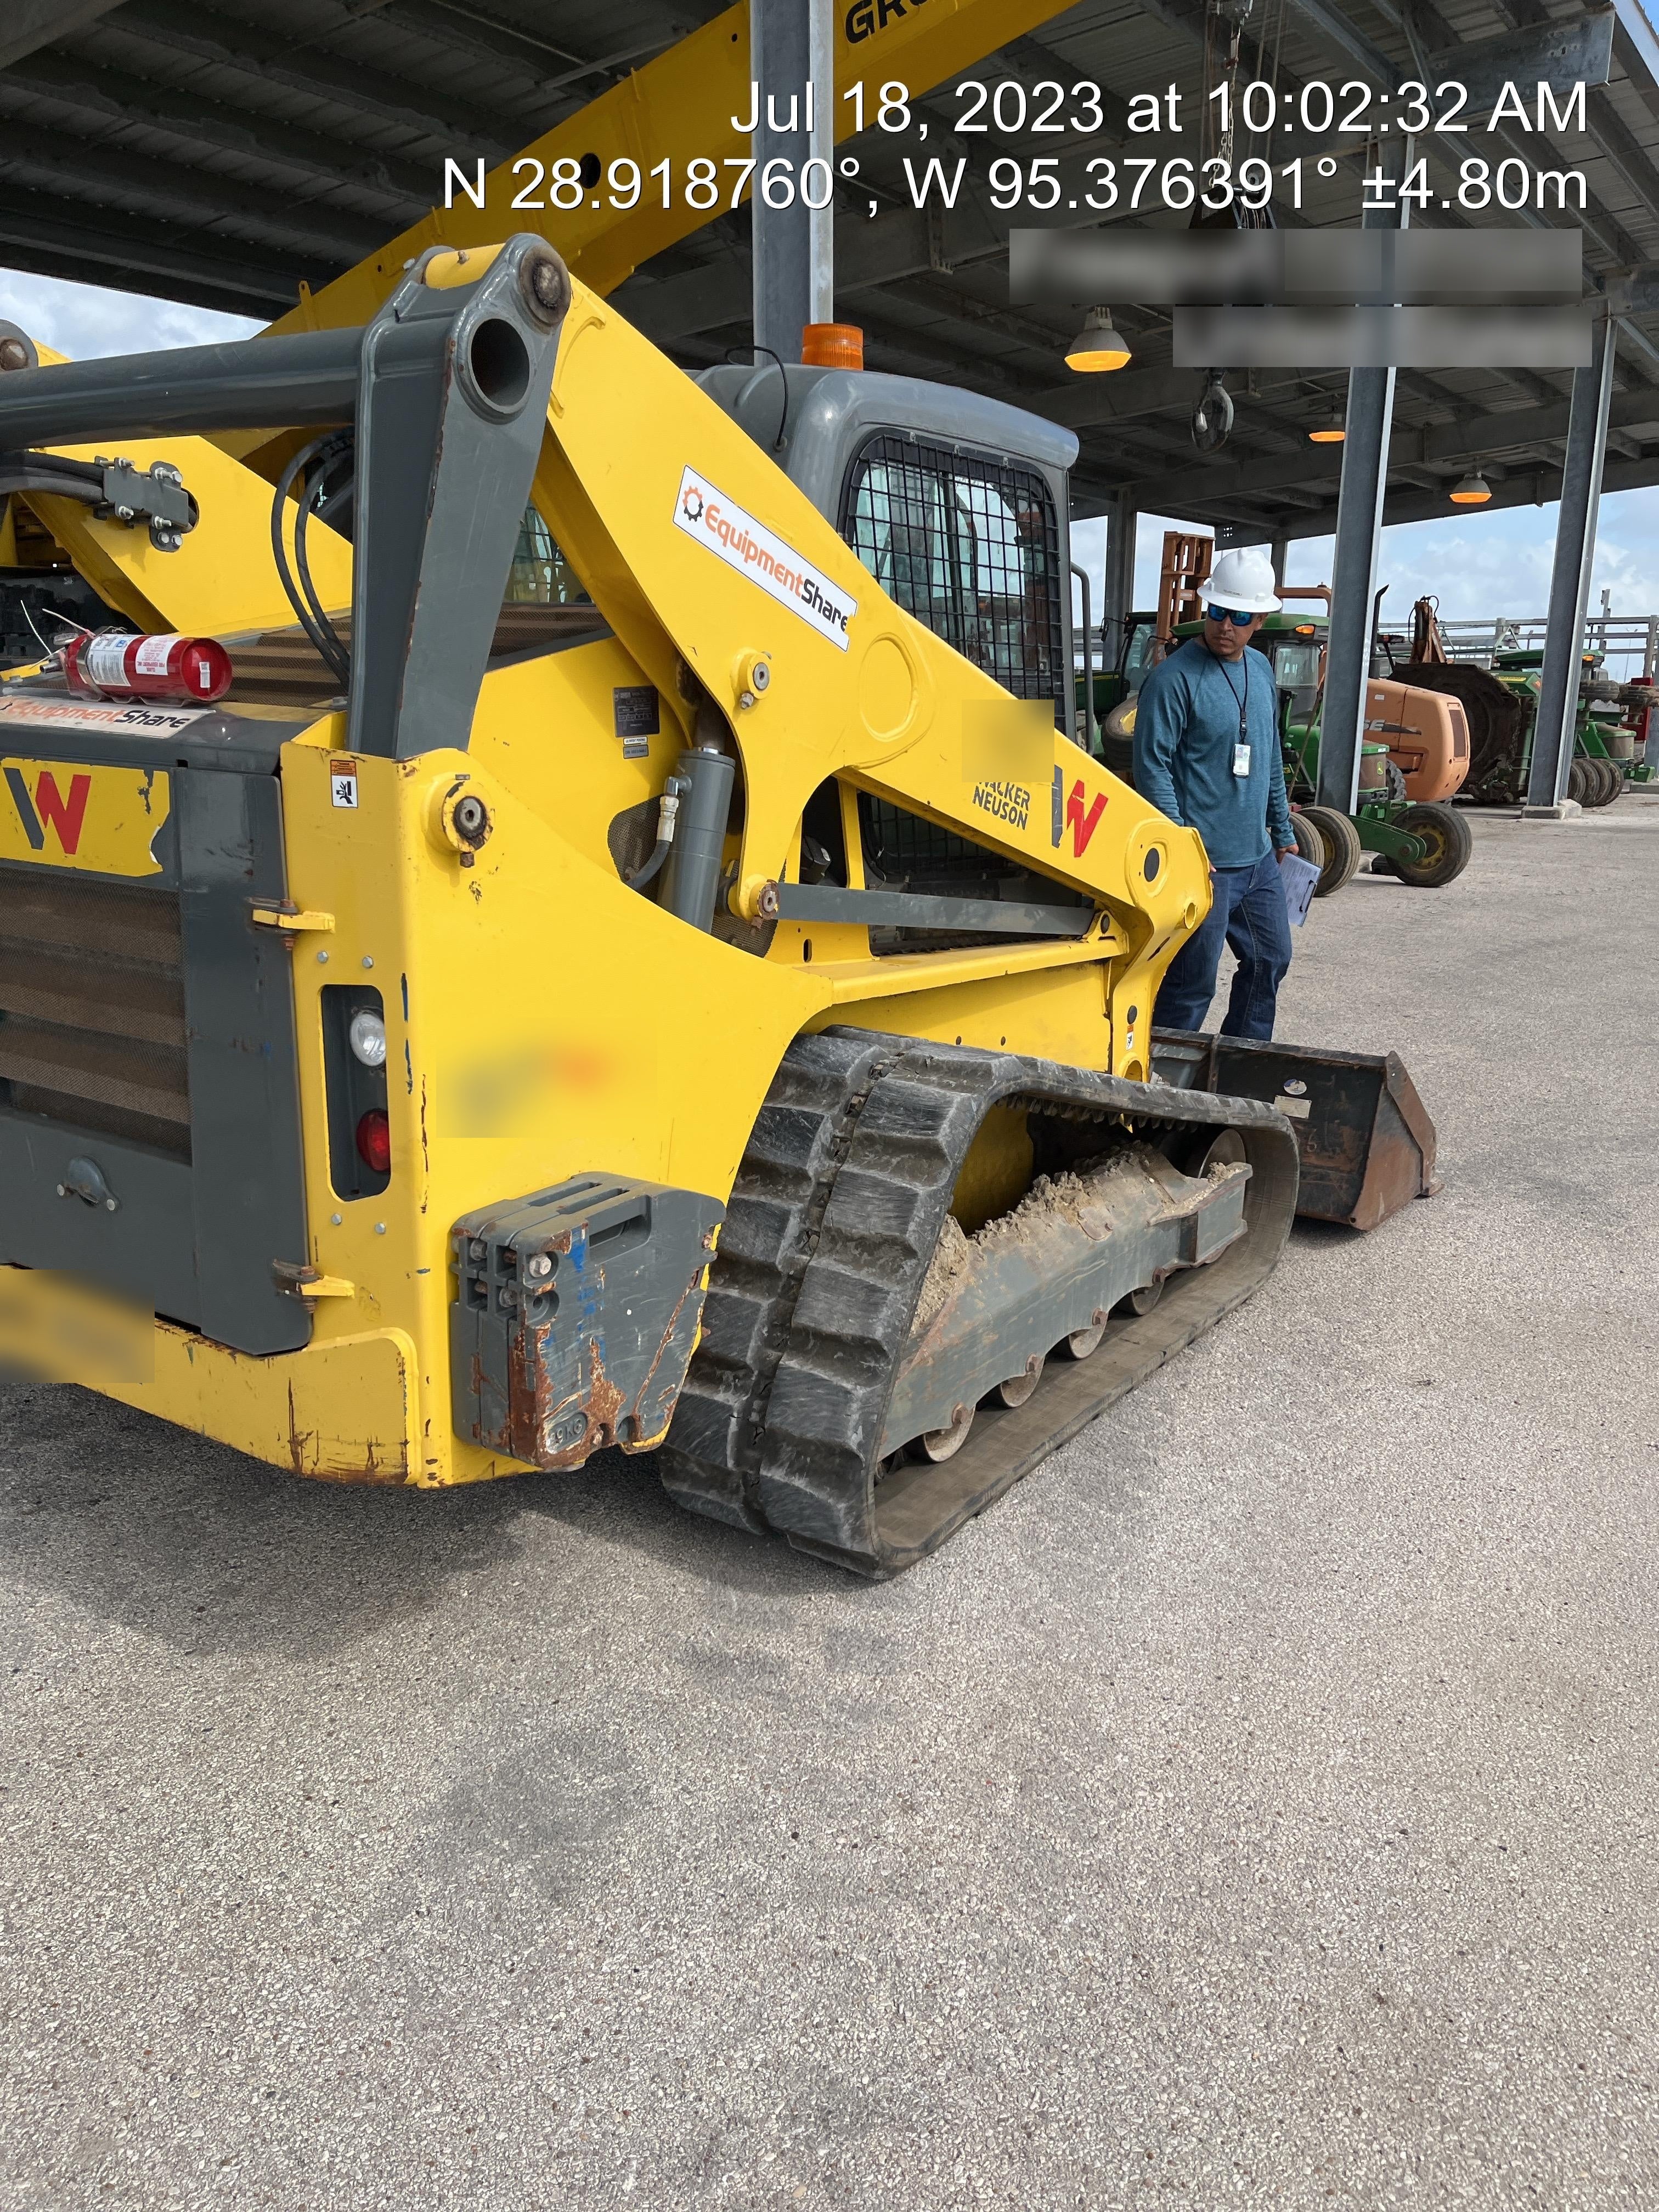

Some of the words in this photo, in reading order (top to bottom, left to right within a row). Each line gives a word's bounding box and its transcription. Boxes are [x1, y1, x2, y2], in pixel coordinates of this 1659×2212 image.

[845, 0, 927, 44] GR
[704, 504, 848, 633] EquipmentShare
[7, 700, 191, 728] EquipmentShare
[972, 785, 1028, 831] NEUSON
